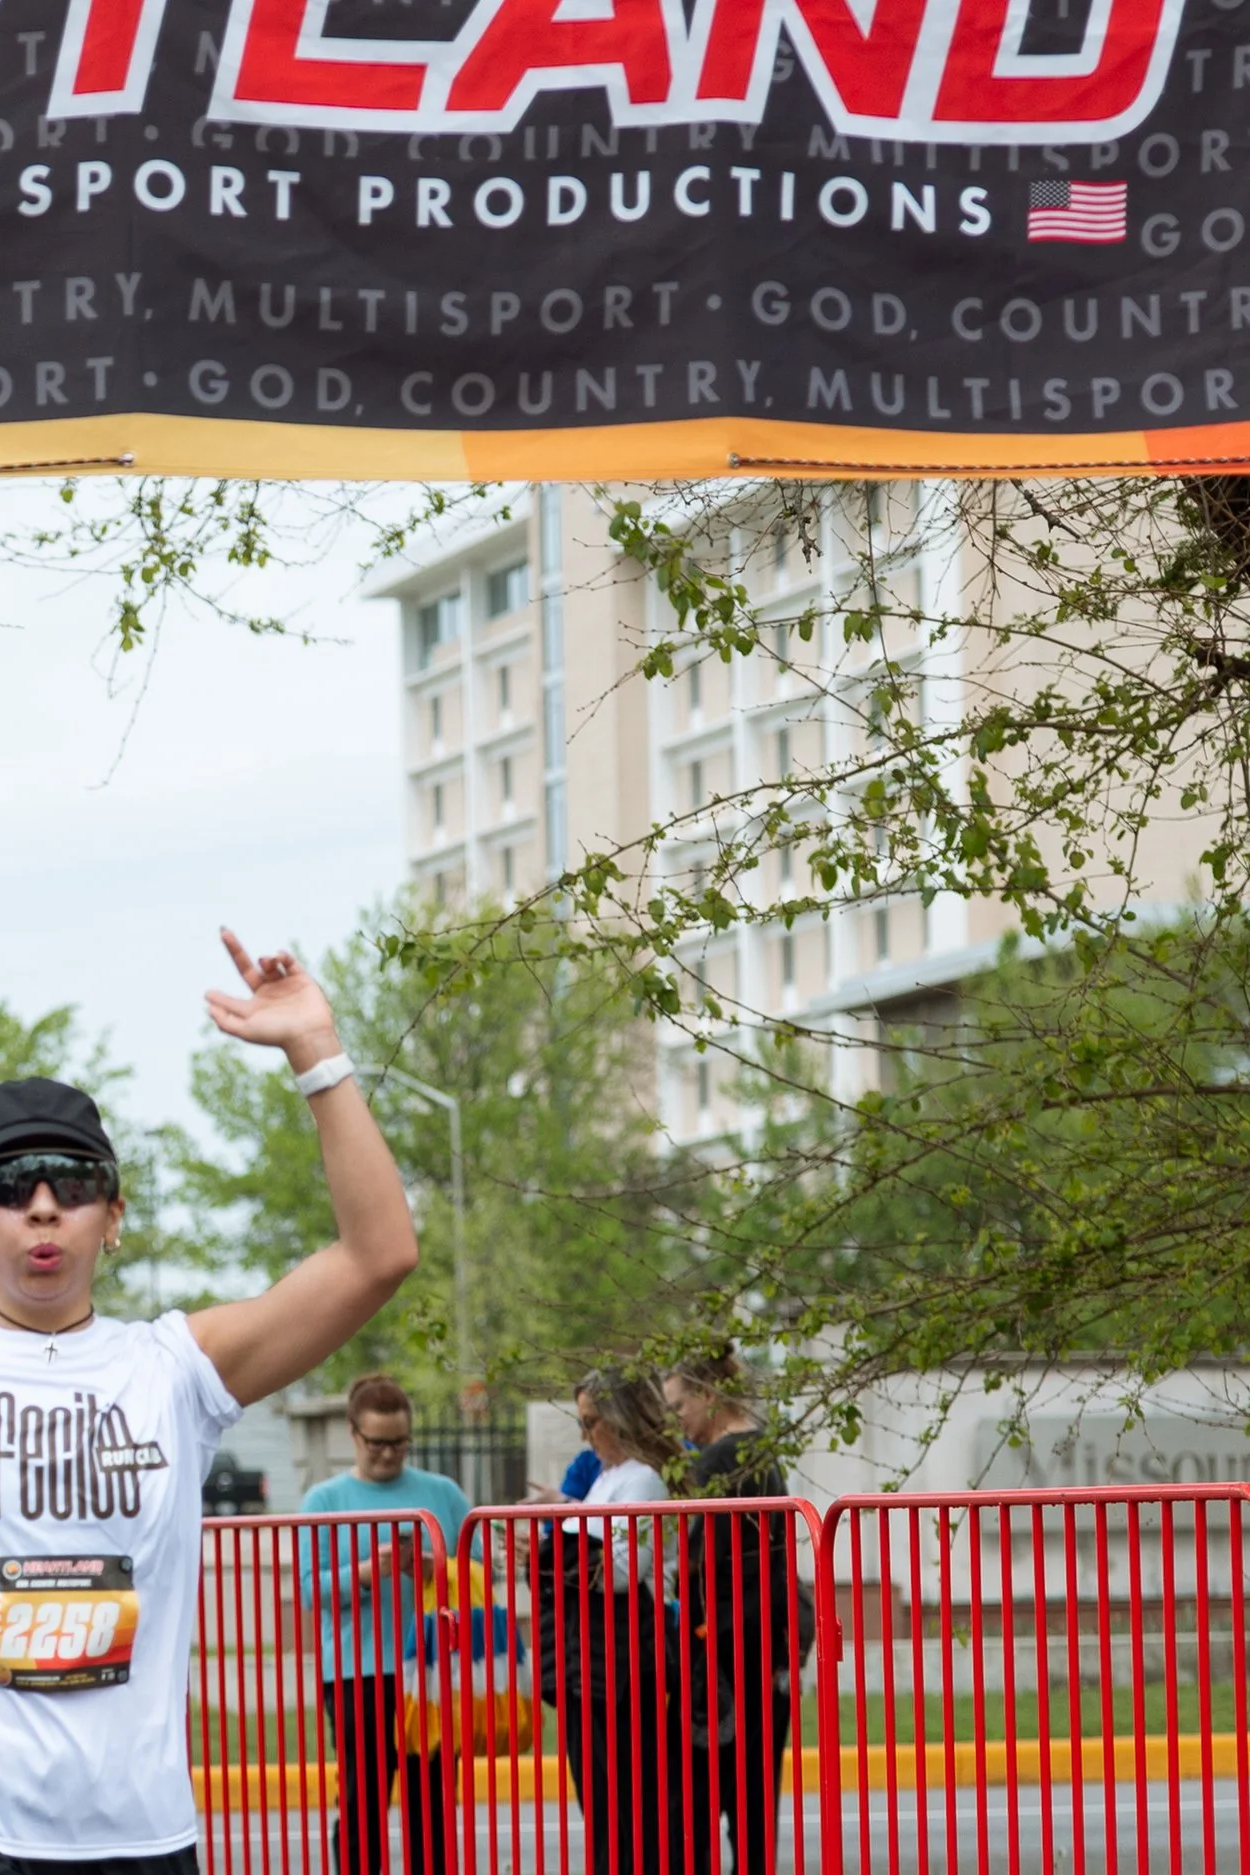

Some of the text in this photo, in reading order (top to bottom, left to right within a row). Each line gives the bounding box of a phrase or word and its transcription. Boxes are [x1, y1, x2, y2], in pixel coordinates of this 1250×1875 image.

[358, 165, 991, 236] PRODUCTIONS
[188, 278, 679, 335] MULTISPORT
[751, 281, 918, 341] GOD,
[188, 360, 363, 418] GOD,
[401, 360, 772, 418] COUNTRY,
[807, 367, 1239, 421] MULTISPOR
